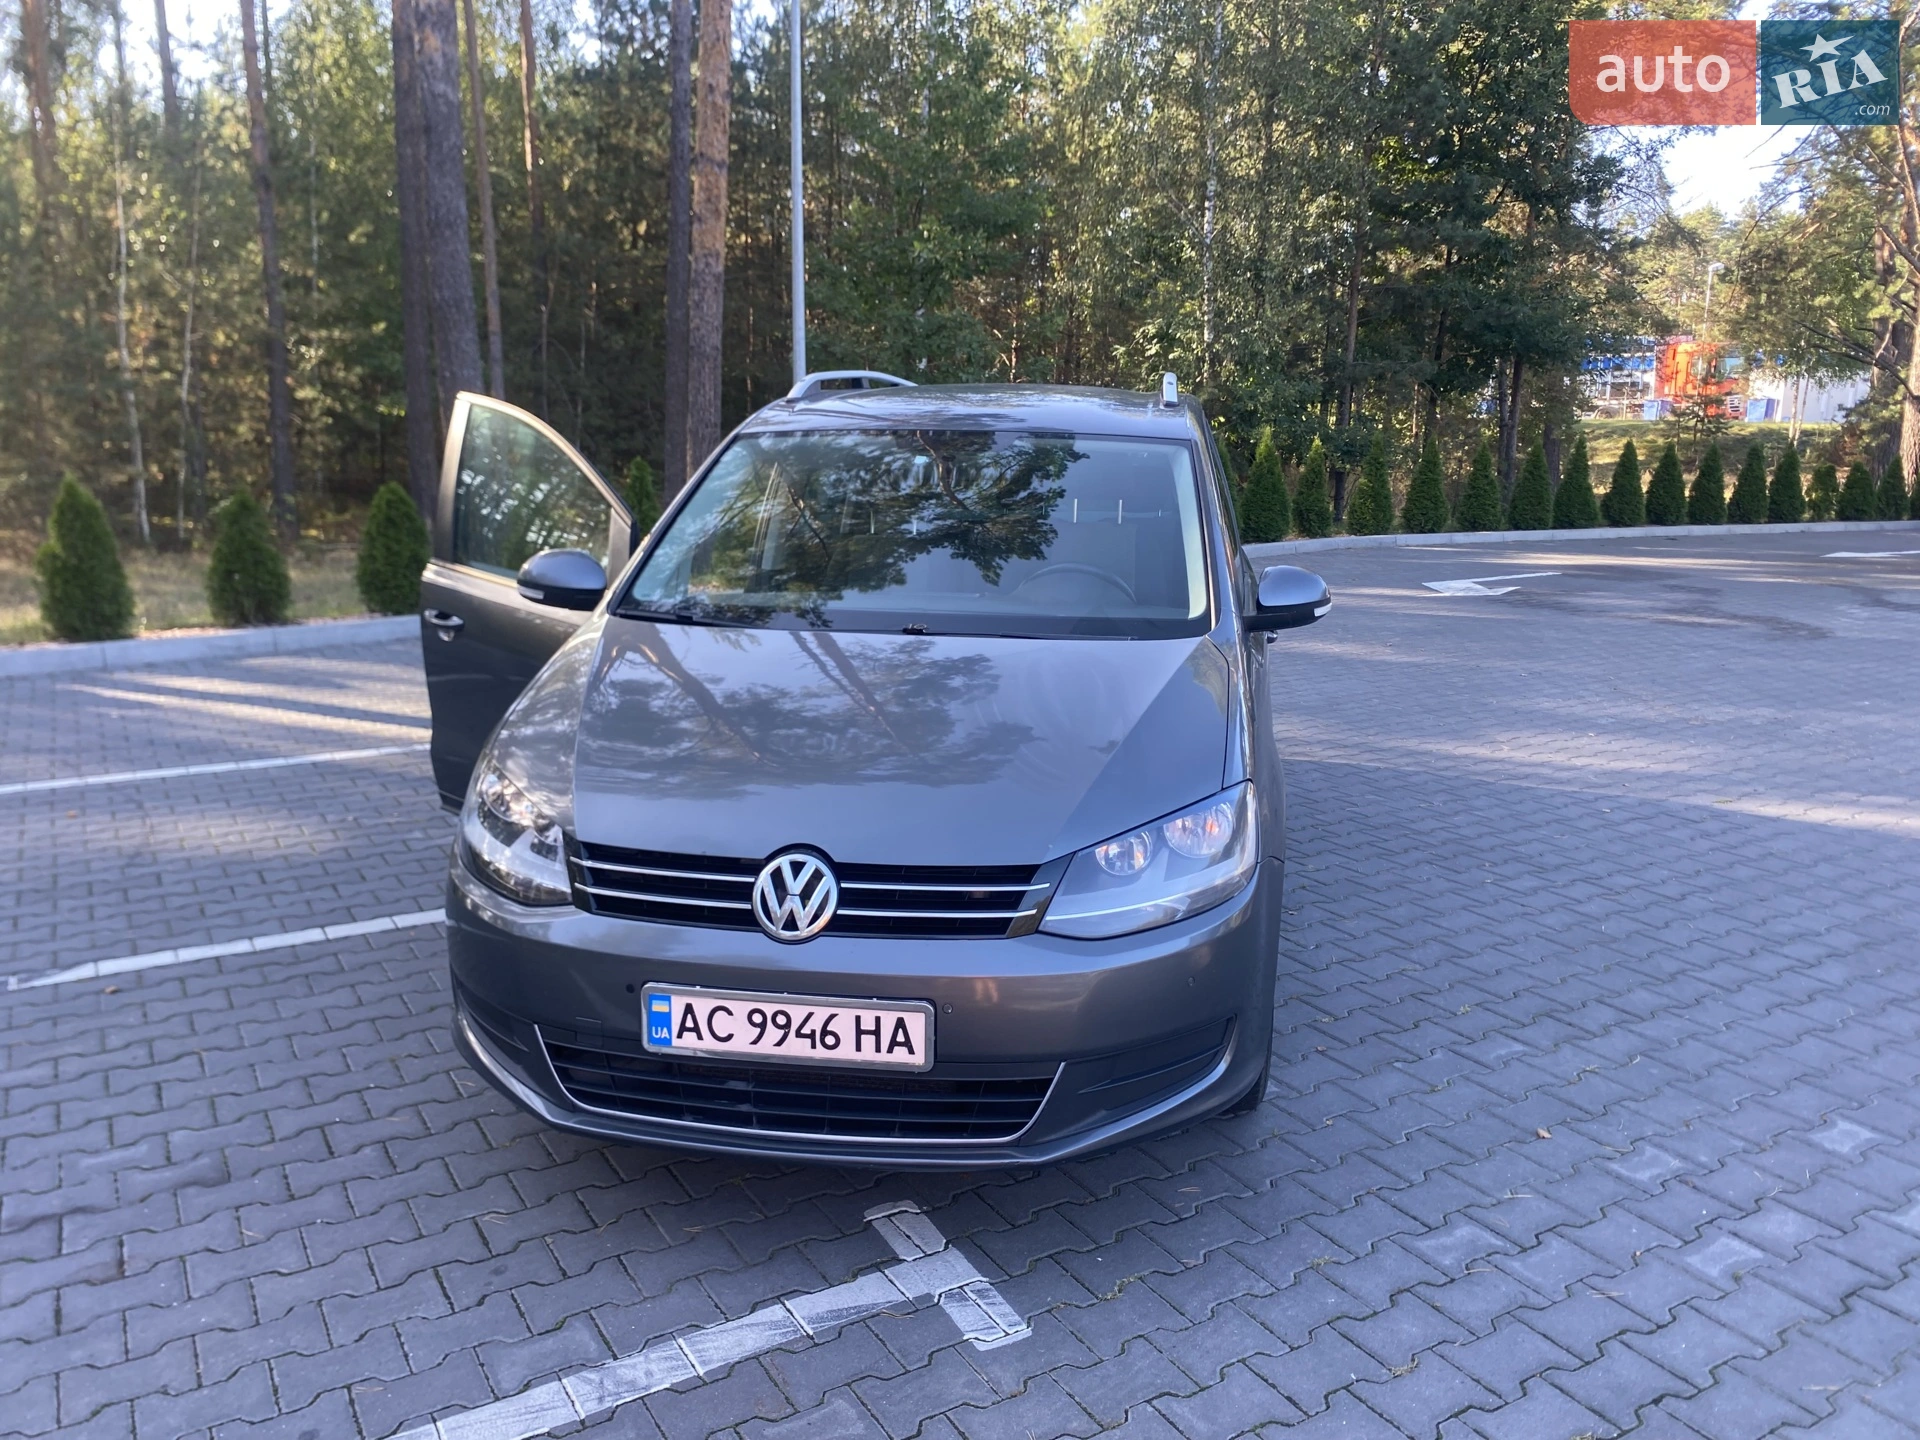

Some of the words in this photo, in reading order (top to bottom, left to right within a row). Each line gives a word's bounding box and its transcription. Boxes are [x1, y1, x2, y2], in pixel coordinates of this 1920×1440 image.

[651, 1026, 670, 1040] UA
[676, 1002, 735, 1043] AC
[746, 1007, 841, 1051] 9946
[855, 1014, 916, 1056] HA
